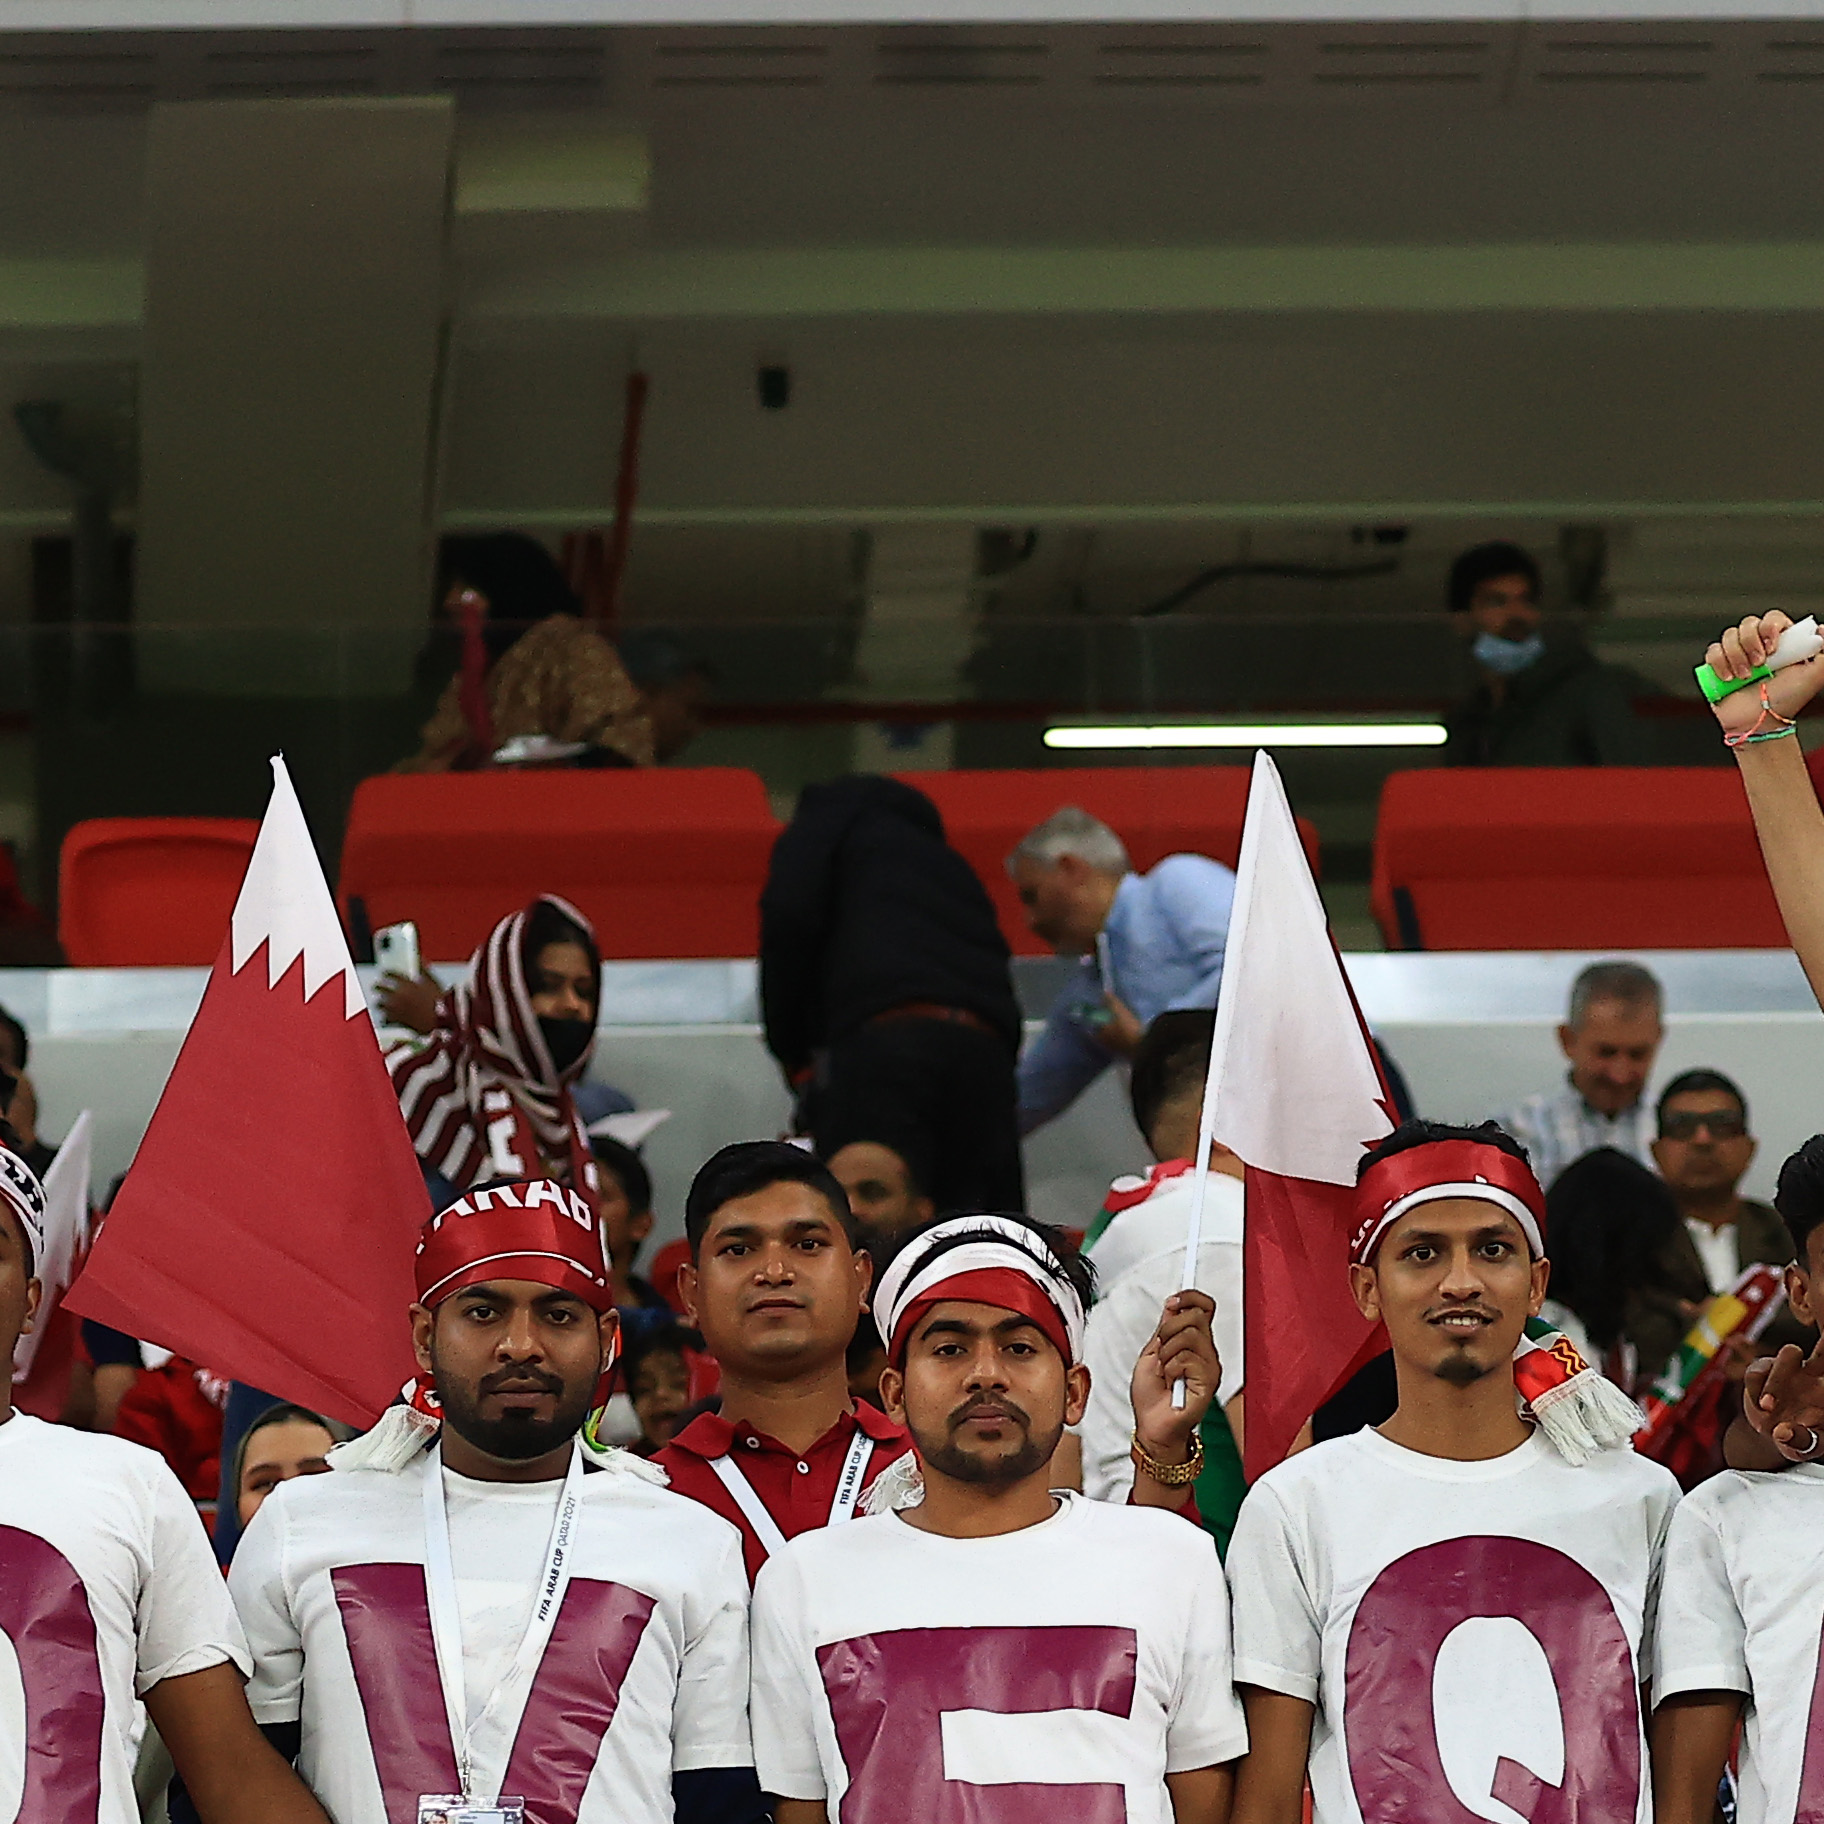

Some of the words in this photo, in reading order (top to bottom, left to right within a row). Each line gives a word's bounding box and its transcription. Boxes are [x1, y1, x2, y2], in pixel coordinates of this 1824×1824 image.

[839, 1488, 852, 1505] FIFA
[846, 1465, 858, 1486] ARAB
[557, 1519, 570, 1547] QATAR
[553, 1547, 564, 1567] CUP
[546, 1567, 560, 1597] ARAB
[538, 1598, 552, 1622] FIFA
